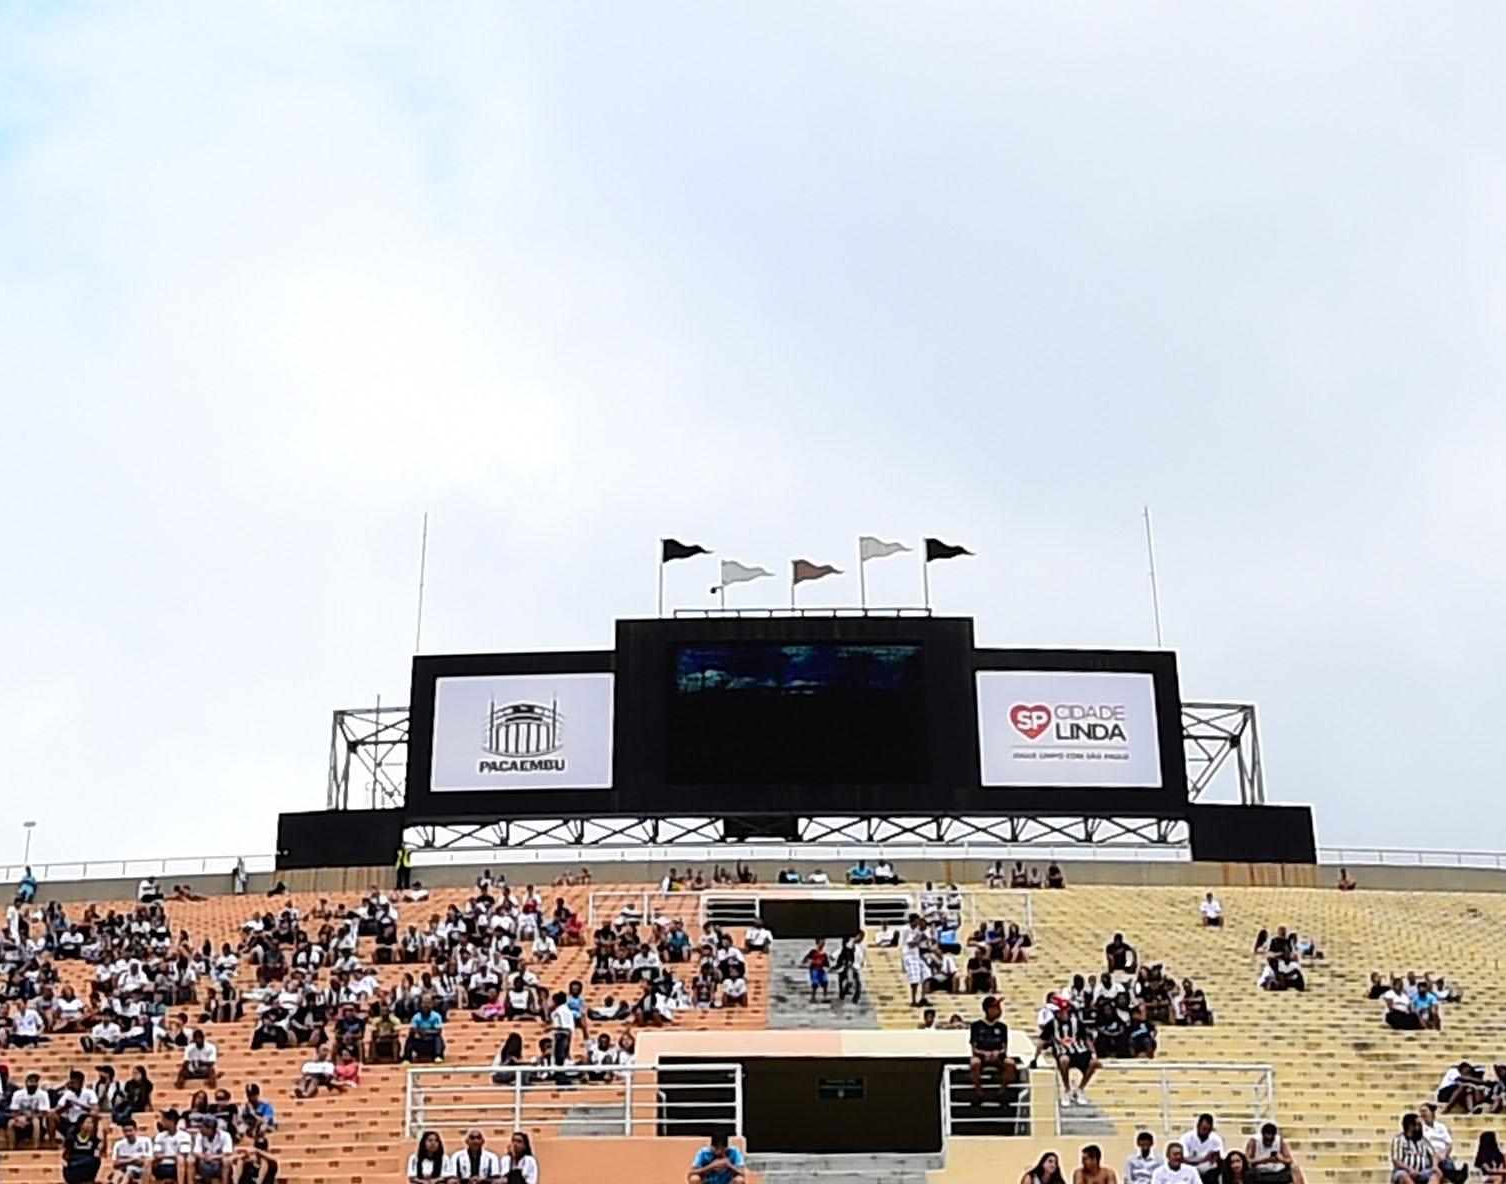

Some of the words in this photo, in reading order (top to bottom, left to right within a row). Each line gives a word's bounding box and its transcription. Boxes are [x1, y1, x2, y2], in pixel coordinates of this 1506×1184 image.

[1016, 710, 1046, 729] SP
[1054, 704, 1125, 721] CIDADE
[1056, 722, 1126, 741] LINDA
[479, 760, 565, 773] PACAEMBU
